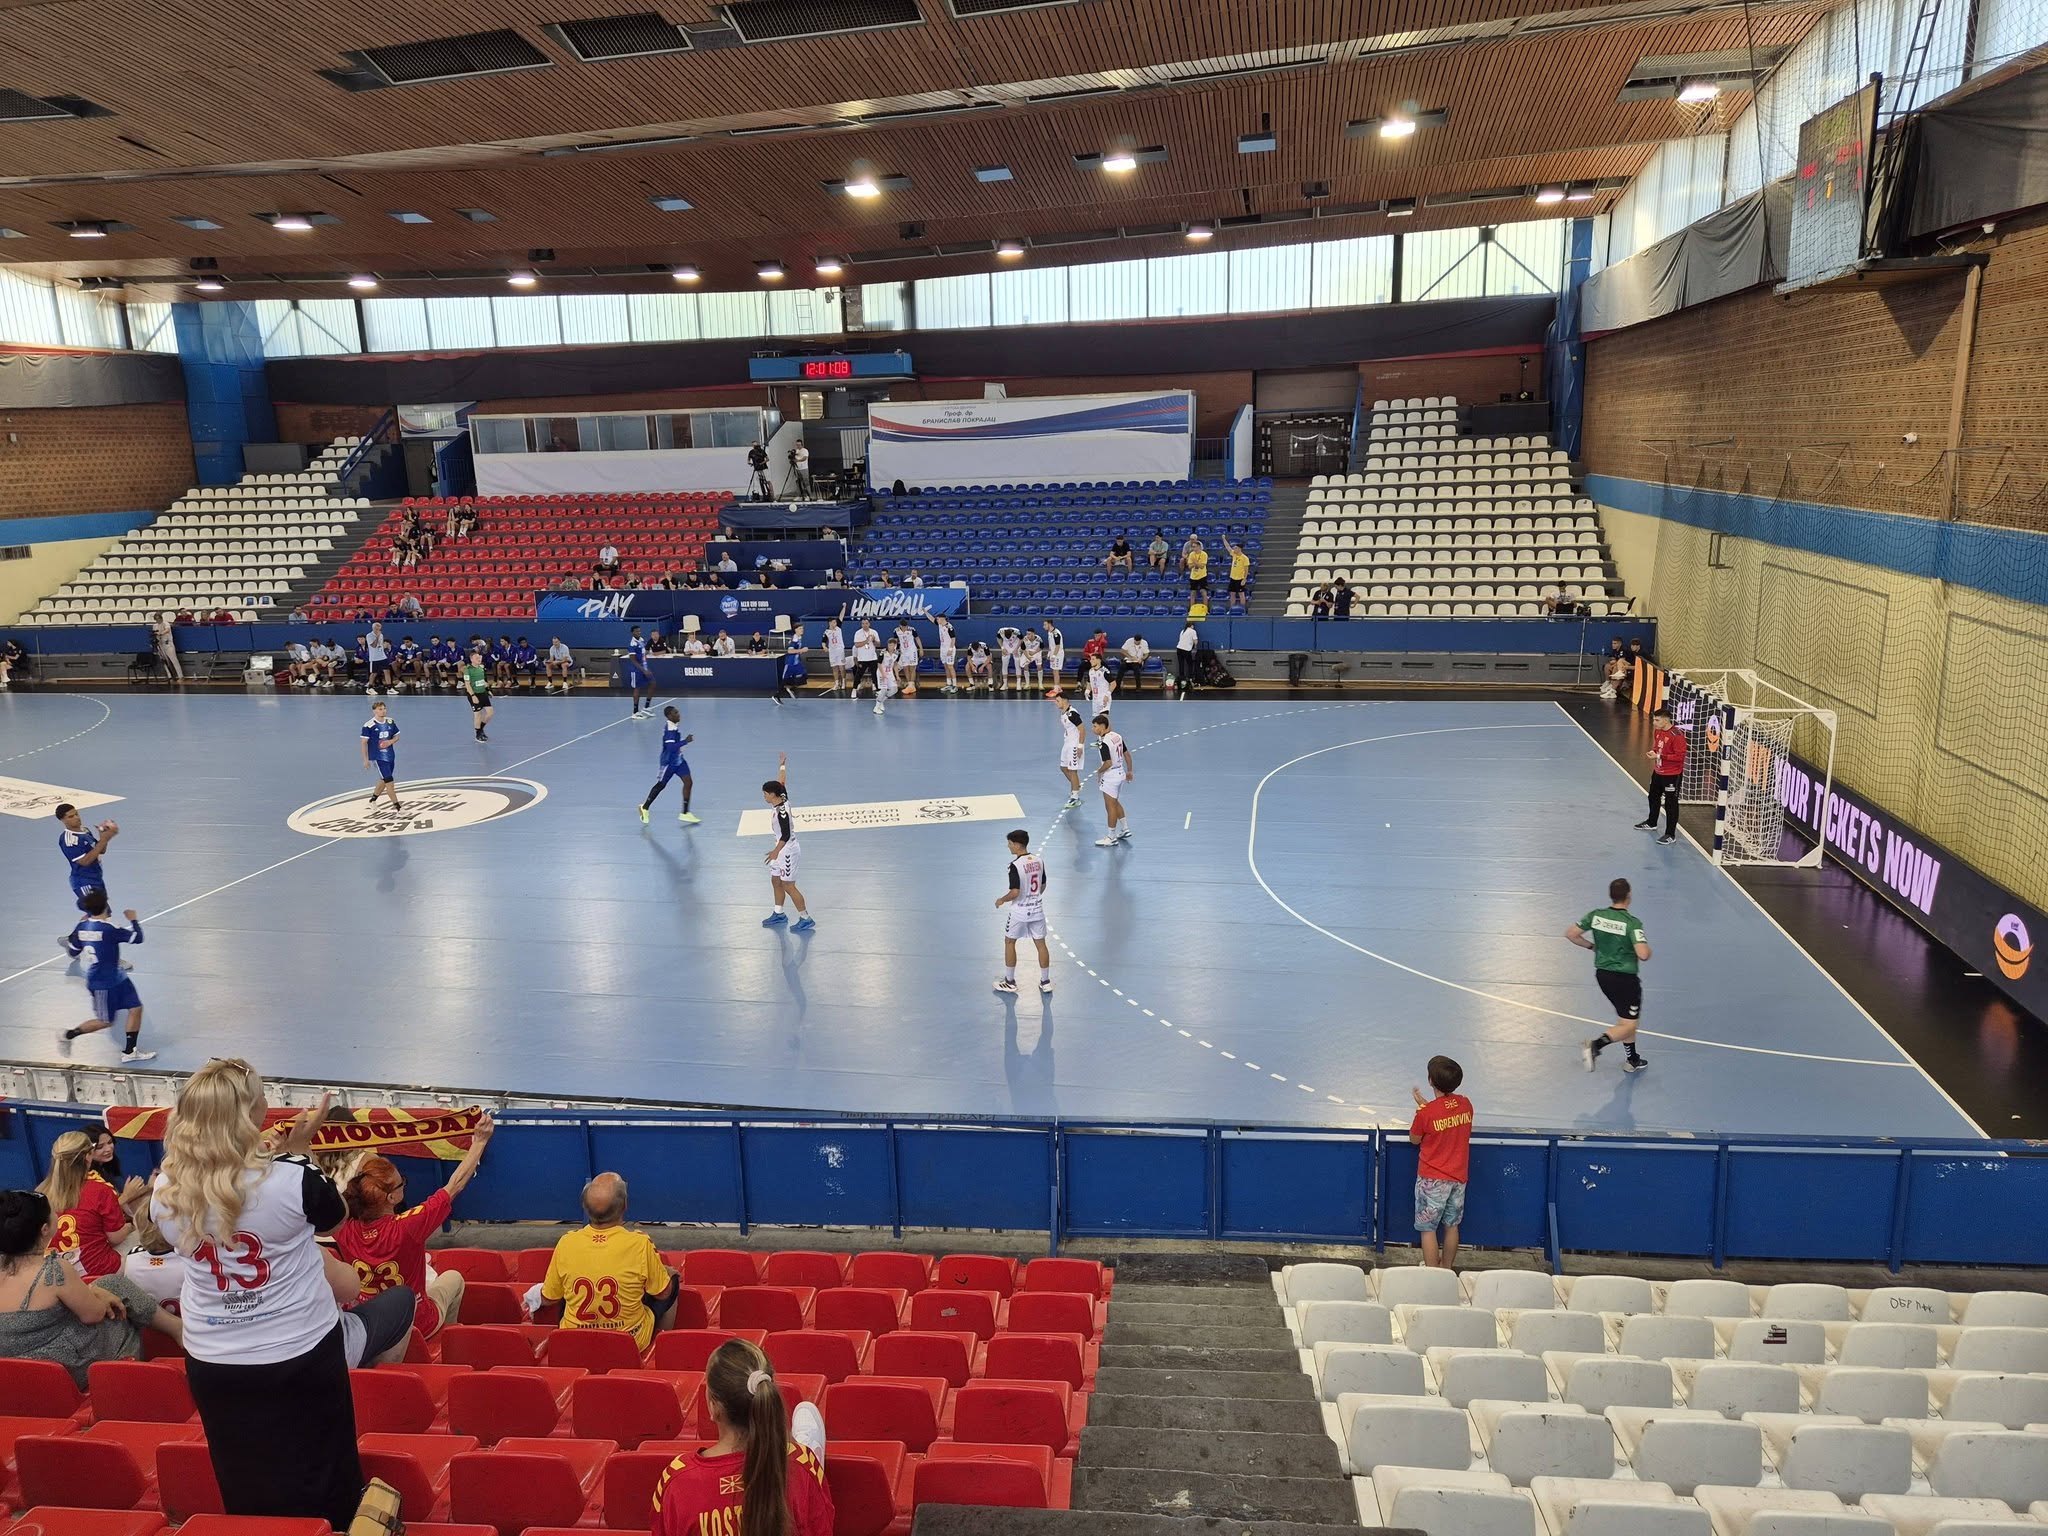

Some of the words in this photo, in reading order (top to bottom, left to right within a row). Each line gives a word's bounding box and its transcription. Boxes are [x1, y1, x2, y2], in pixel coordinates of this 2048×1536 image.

[806, 361, 849, 376] 12:01:08
[577, 592, 635, 621] PLAY
[850, 590, 932, 620] HANDBALL
[684, 667, 714, 677] BELGRADE
[308, 817, 434, 833] RESPECT
[850, 817, 900, 825] БАНКА
[1774, 754, 1810, 824] YOUR
[1812, 781, 1883, 875] TCKETS
[1883, 829, 1941, 917] NOW
[1030, 873, 1039, 893] 5
[191, 1231, 271, 1292] 13
[352, 1259, 405, 1295] 23
[573, 1275, 621, 1320] 23
[699, 1505, 744, 1536] KOST
